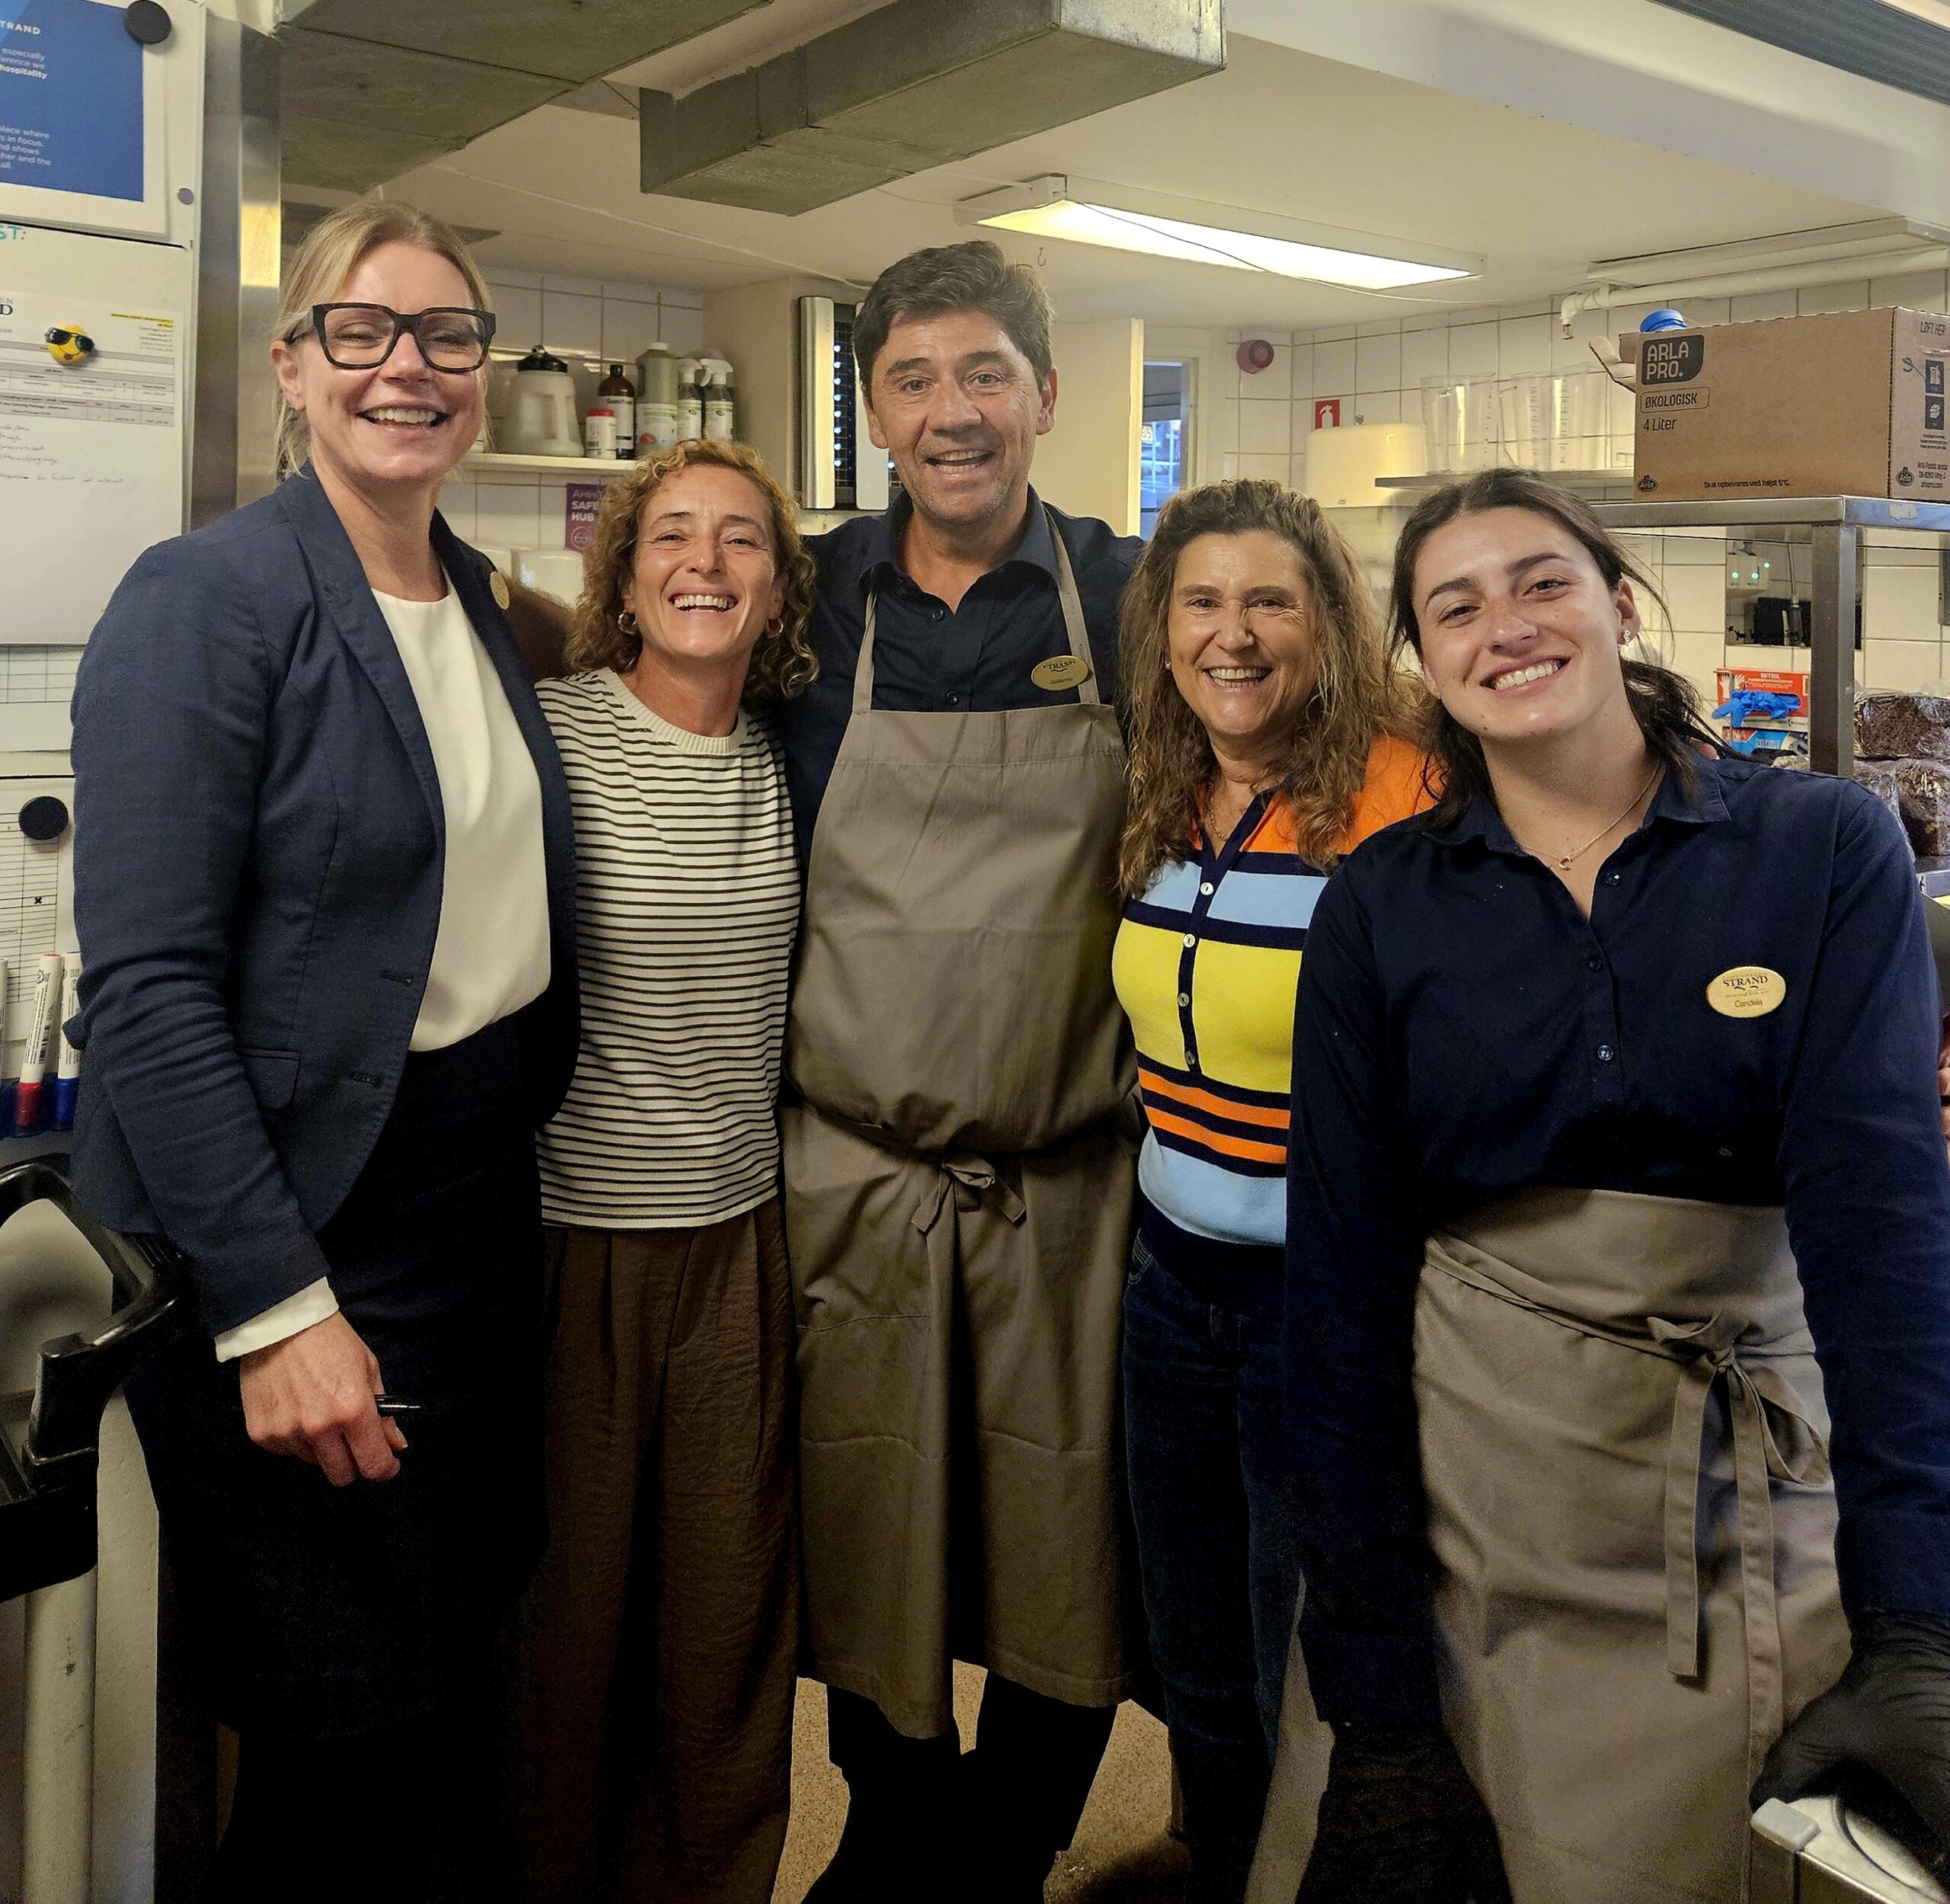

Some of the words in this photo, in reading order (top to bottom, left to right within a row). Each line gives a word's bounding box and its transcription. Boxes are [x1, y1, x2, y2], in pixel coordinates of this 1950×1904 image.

[23, 129, 50, 139] where
[37, 157, 53, 166] the
[1648, 341, 1689, 362] ARLA
[1646, 360, 1683, 380] PRO.
[1645, 392, 1698, 408] ØKOLOGISK
[1643, 419, 1650, 432] 4
[1652, 418, 1677, 431] Liter
[571, 512, 594, 522] HUB
[1723, 975, 1768, 987] STRAND
[1734, 999, 1763, 1008] Candela
